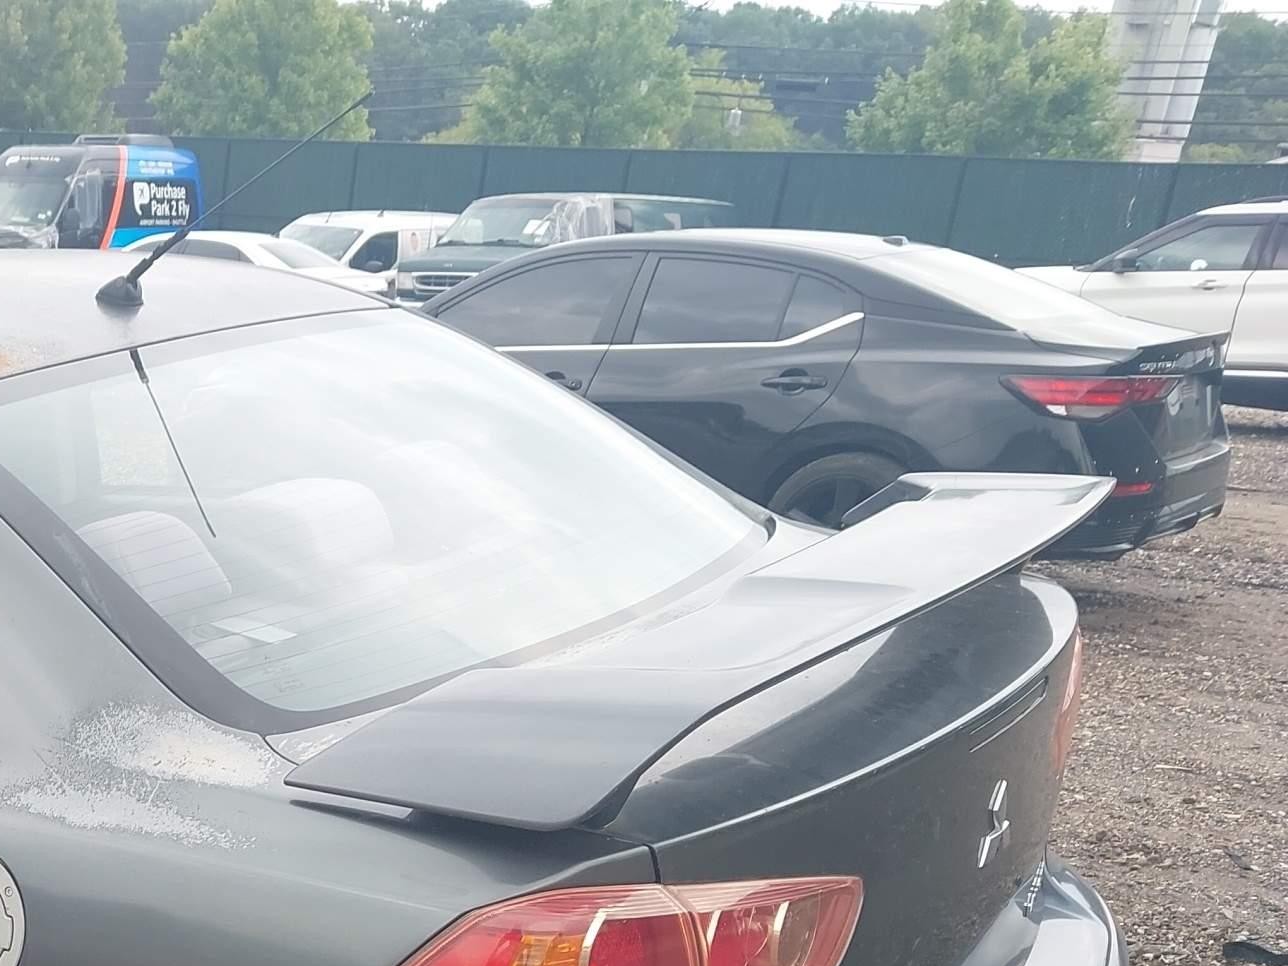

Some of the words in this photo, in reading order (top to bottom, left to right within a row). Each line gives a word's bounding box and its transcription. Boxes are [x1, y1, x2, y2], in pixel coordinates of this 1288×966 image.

[150, 182, 186, 198] Purchase
[151, 200, 169, 216] Park
[171, 201, 177, 216] 2
[178, 200, 190, 222] Fly
